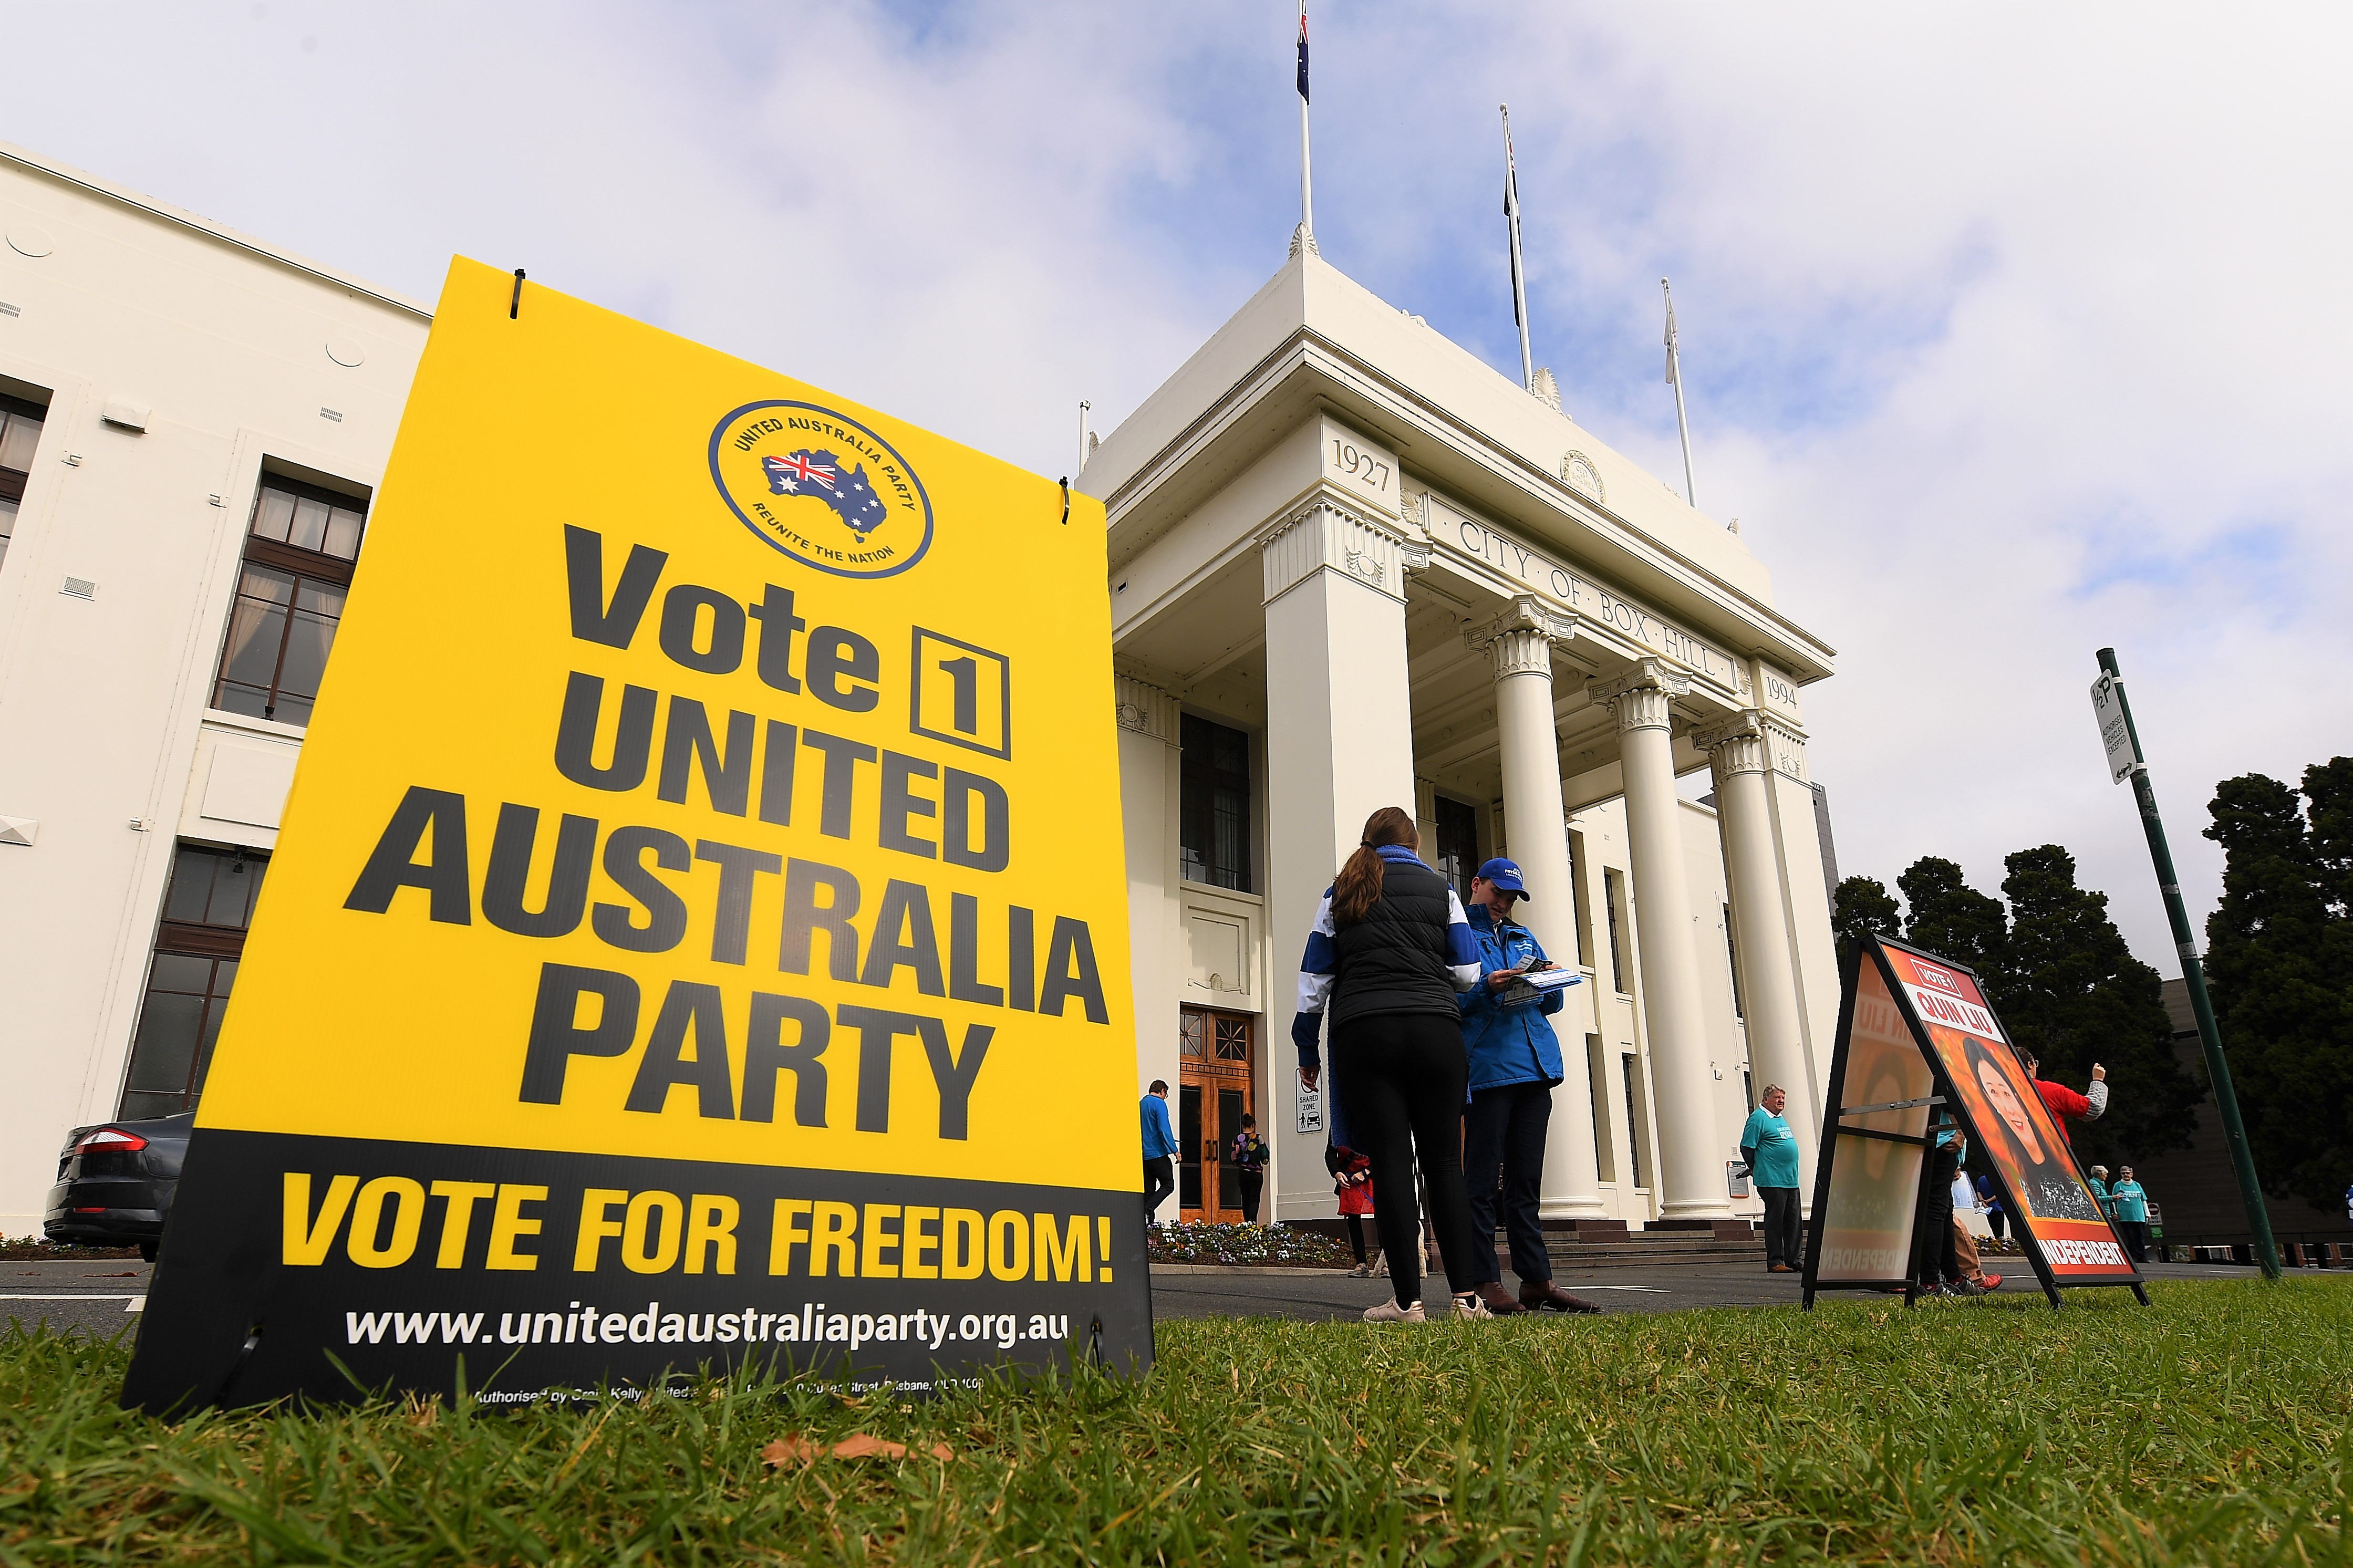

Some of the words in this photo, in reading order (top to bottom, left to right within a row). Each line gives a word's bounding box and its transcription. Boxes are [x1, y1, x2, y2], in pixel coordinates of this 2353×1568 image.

[734, 418, 783, 452] UNITED
[788, 417, 881, 464] AUSTRALIA
[882, 465, 916, 512] PARTY
[1332, 440, 1390, 492] 1927
[753, 502, 810, 549] REUNITE
[814, 544, 844, 562] THE
[848, 545, 895, 564] NATION
[1460, 521, 1531, 579] CITY
[1551, 569, 1581, 606] OF
[1599, 591, 1651, 643] BOX
[1662, 626, 1716, 677] HILL
[564, 523, 880, 713] Vote
[938, 655, 978, 736] 1
[1766, 676, 1797, 710] 1994
[2106, 725, 2123, 745] VEHICLES
[2108, 734, 2127, 755] EXCEPTED
[554, 671, 1009, 873] UNITED
[342, 785, 1110, 1025] AUSTRALIA
[1919, 967, 1950, 988] VOTE
[1945, 977, 1955, 990] 1
[1917, 991, 1967, 1026] QUIN
[1960, 1005, 1993, 1034] LIU
[518, 962, 996, 1141] PARTY
[1299, 1095, 1319, 1103] SHARED
[282, 1172, 550, 1271] VOTE
[573, 1188, 740, 1275] FOR
[768, 1199, 1113, 1284] FREEDOM!
[2036, 1239, 2127, 1265] INDEPENDENT
[346, 1301, 1069, 1351] www.unitedaustraliaparty.org.au
[572, 1388, 603, 1401] Crai
[884, 1380, 932, 1392] Bisbane,
